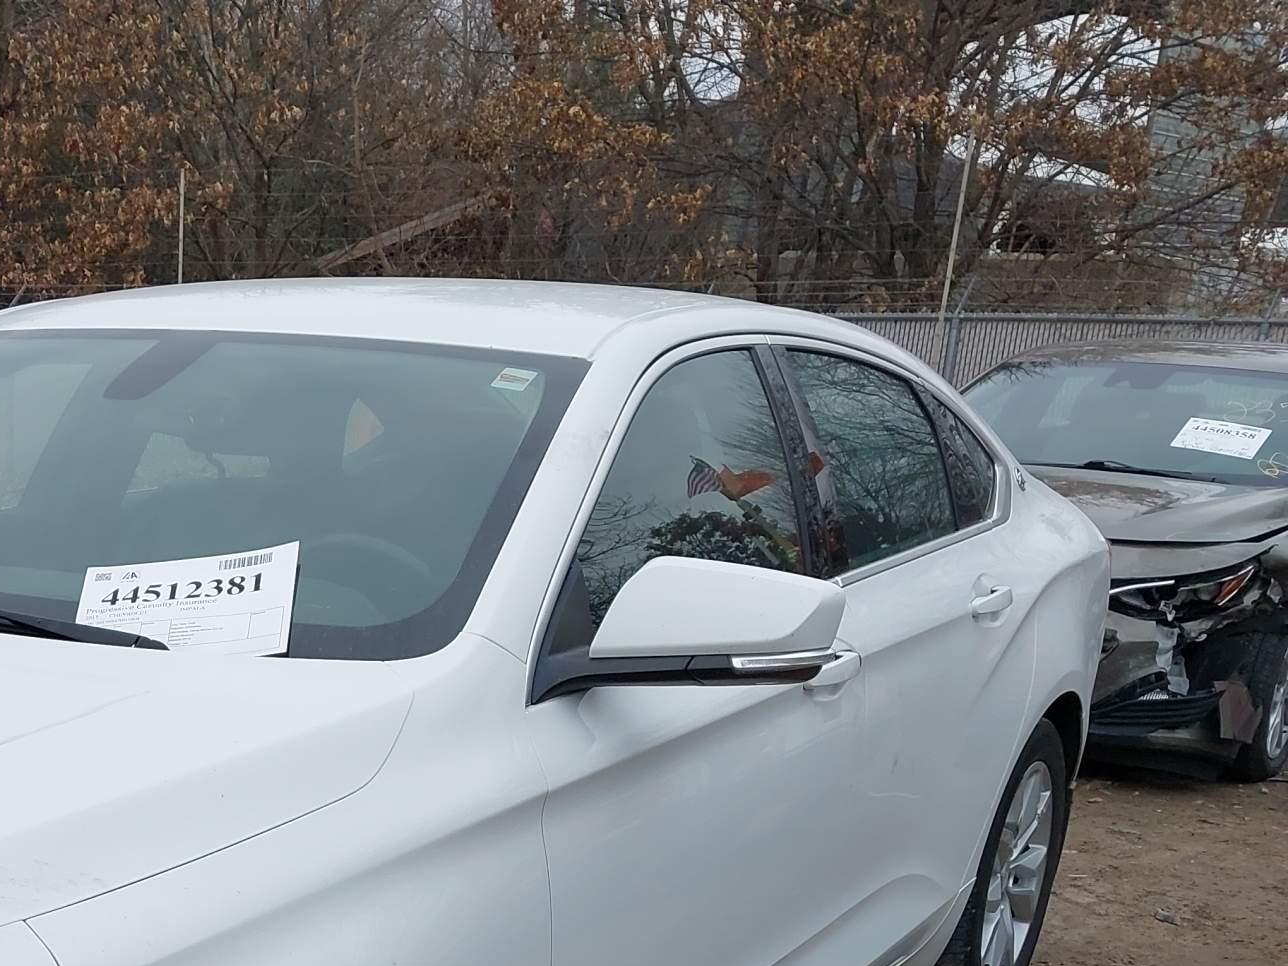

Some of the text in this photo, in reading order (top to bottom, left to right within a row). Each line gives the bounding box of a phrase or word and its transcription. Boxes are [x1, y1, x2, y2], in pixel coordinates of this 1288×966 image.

[101, 572, 264, 606] 44512381
[86, 604, 135, 615] Progressive
[176, 598, 217, 607] Insurance
